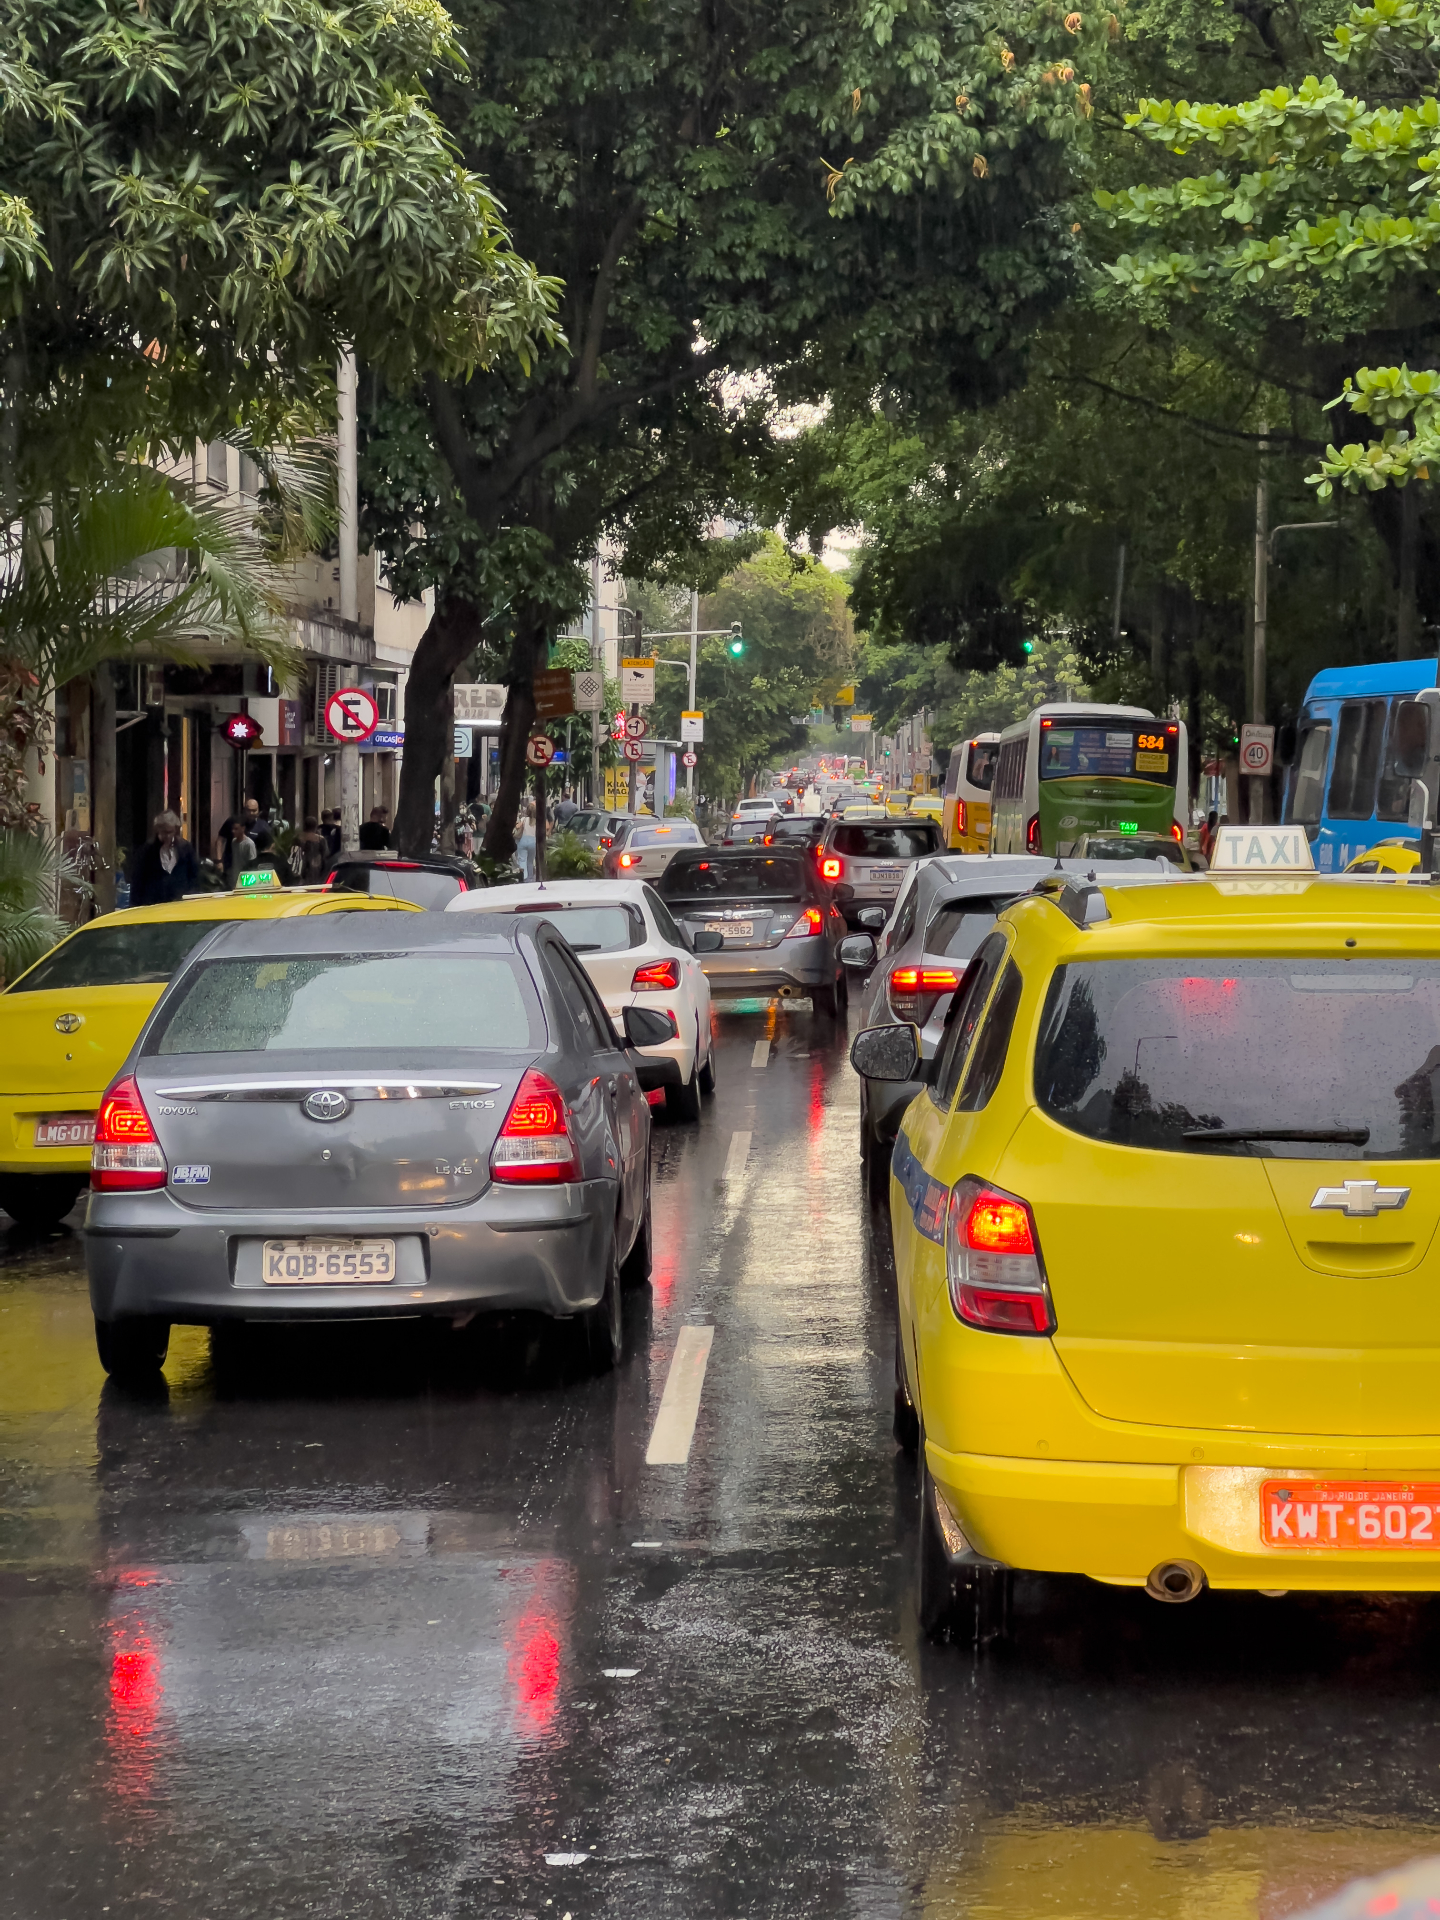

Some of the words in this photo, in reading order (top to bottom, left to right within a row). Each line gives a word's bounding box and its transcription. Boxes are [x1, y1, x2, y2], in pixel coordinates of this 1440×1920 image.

[1138, 734, 1165, 750] 584
[1248, 746, 1264, 760] 40
[1120, 822, 1139, 831] TAXI
[1225, 835, 1300, 865] TAXI
[449, 1100, 496, 1110] ETIOS
[158, 1106, 198, 1116] TOYOTA
[1358, 1492, 1369, 1501] DE
[1372, 1492, 1414, 1501] JANEIRO
